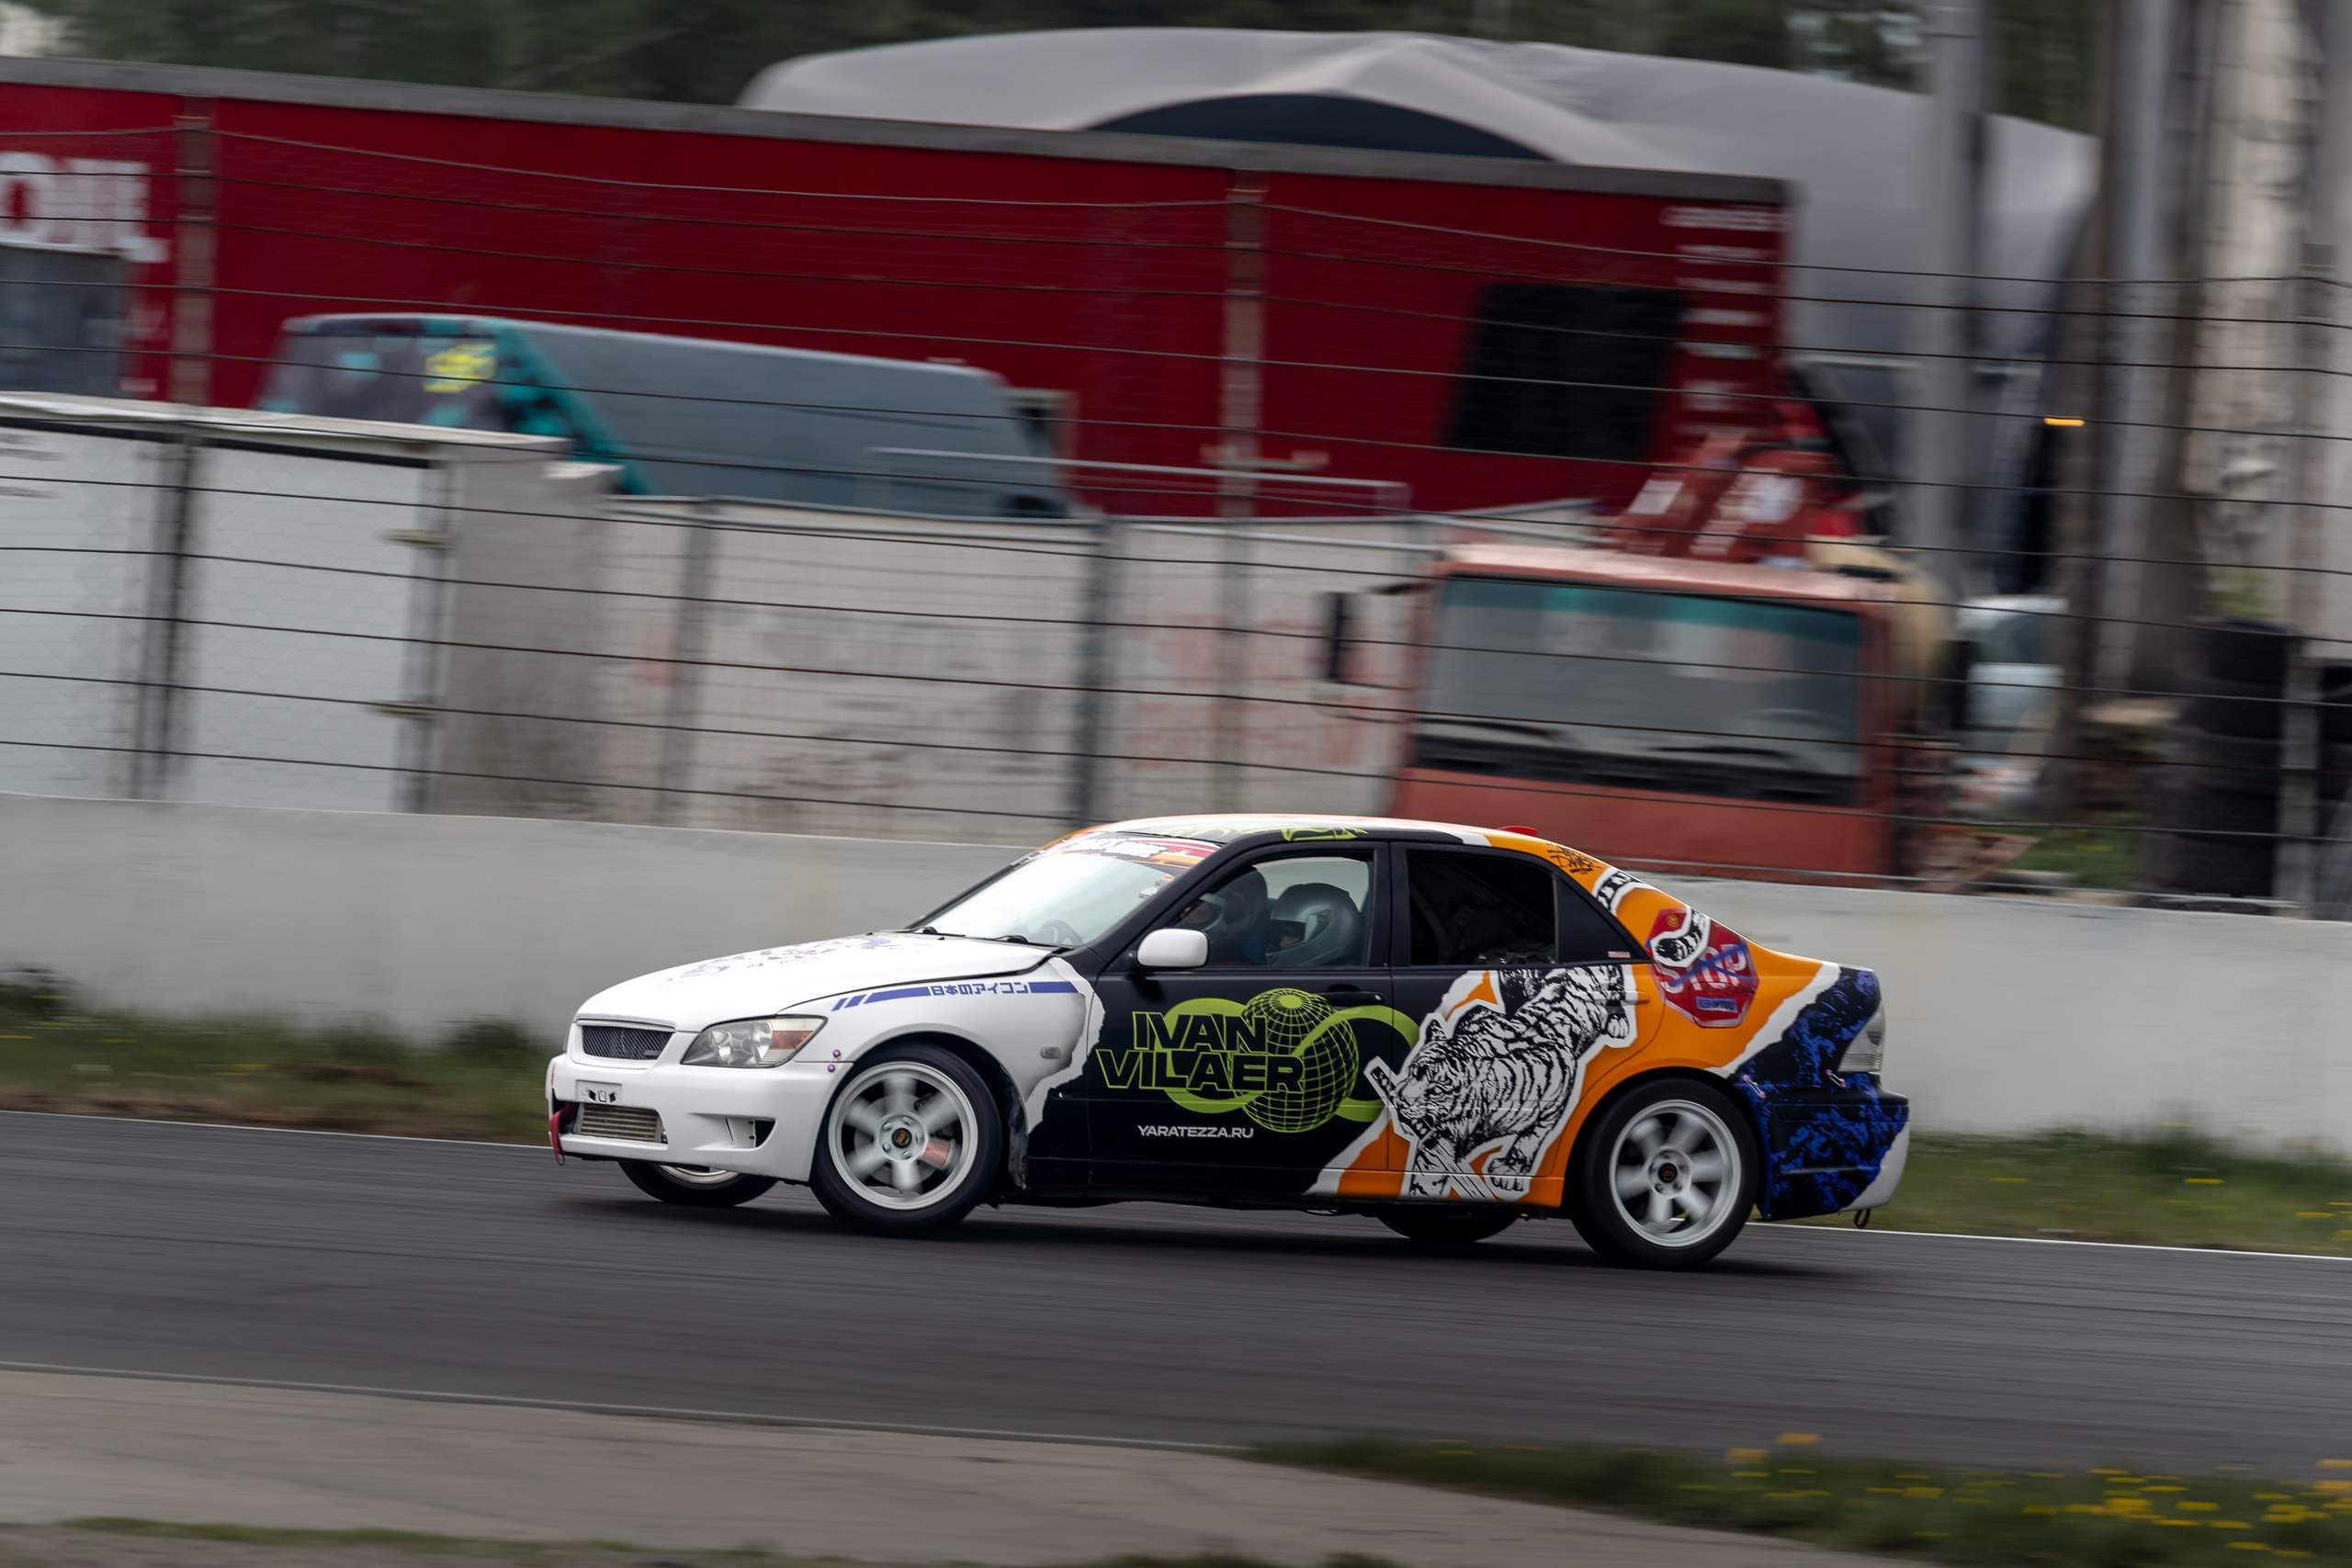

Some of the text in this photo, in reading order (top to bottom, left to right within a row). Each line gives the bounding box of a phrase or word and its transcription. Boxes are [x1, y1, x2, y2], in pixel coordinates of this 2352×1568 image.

[930, 982, 1029, 996] 日本のアイコン
[1655, 943, 1747, 994] STOP
[1133, 1010, 1268, 1054] IVAN
[1095, 1049, 1306, 1093] VILAER
[1137, 1125, 1254, 1138] YARATEZZA.RU
